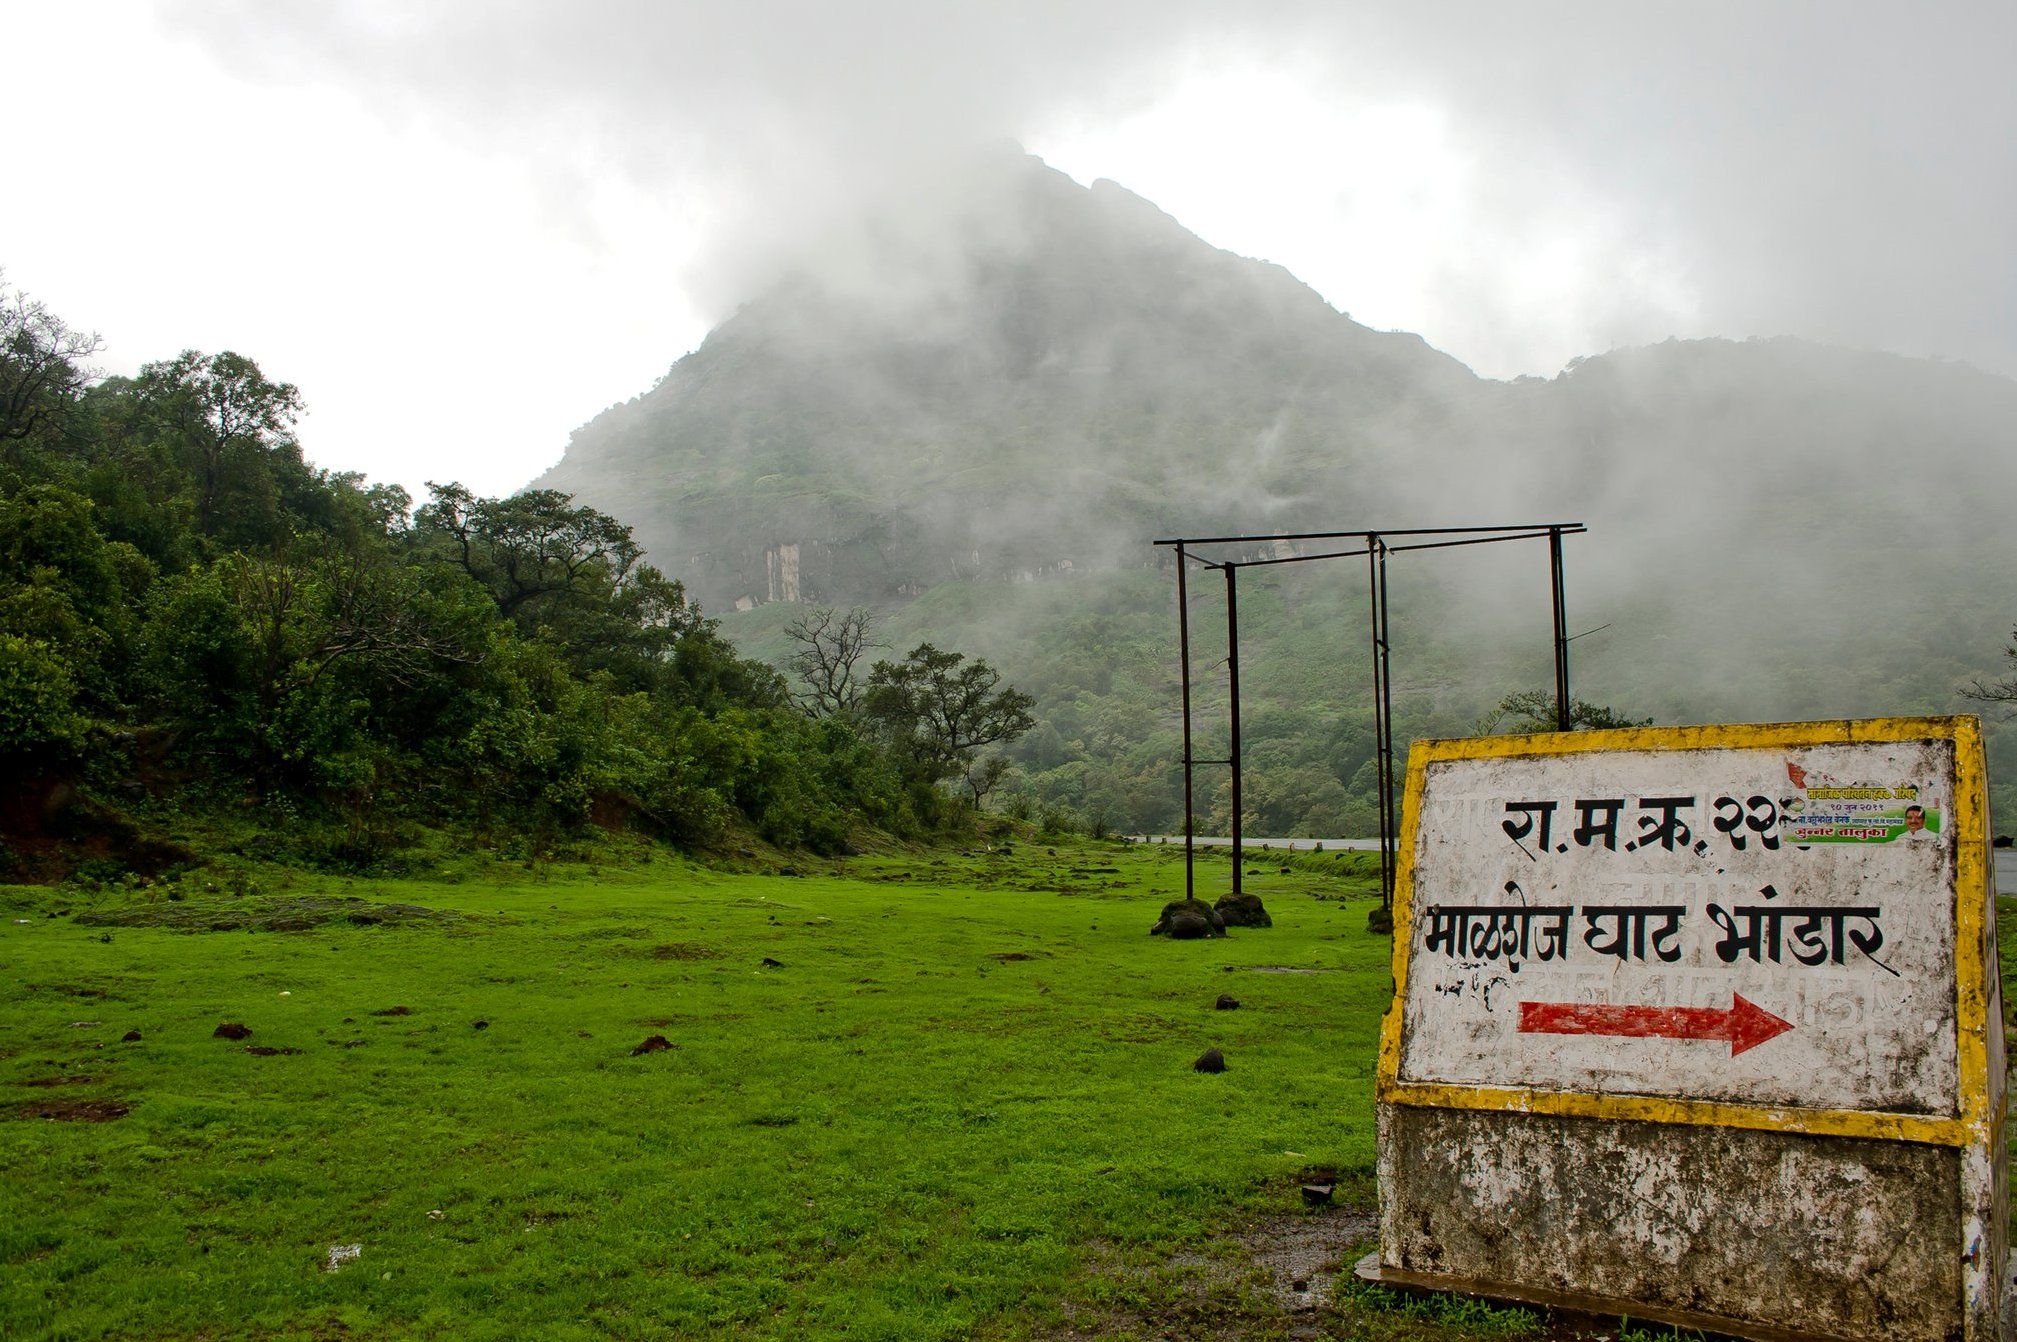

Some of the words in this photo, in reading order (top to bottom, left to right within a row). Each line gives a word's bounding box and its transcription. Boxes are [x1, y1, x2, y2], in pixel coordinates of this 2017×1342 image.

[1795, 827, 1834, 839] जुन्नर
[1838, 828, 1887, 839] तालुका
[1425, 880, 1574, 974] माळशेज
[1581, 904, 1687, 964] घाट
[1705, 884, 1902, 978] भांडार
